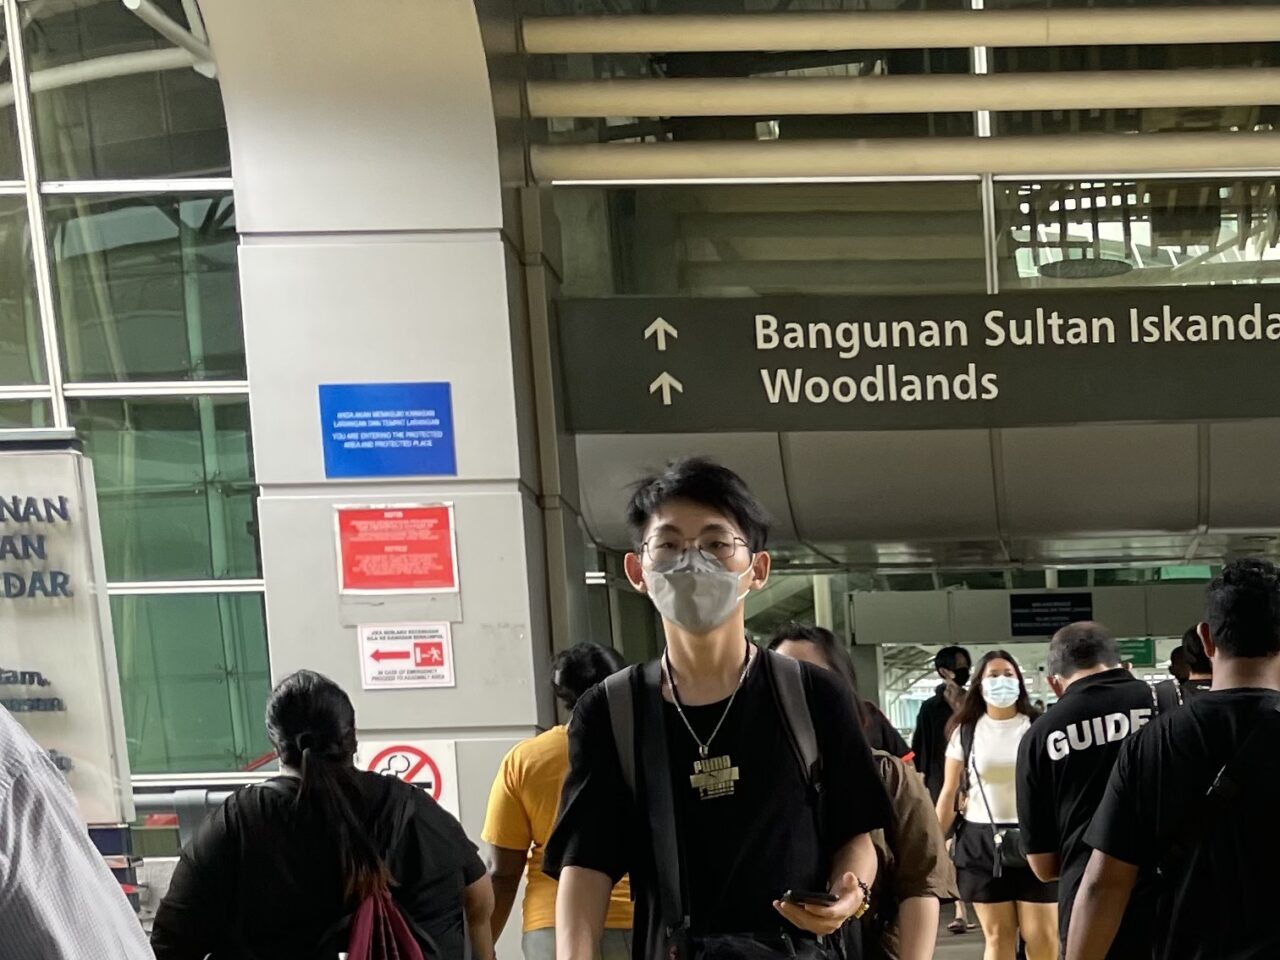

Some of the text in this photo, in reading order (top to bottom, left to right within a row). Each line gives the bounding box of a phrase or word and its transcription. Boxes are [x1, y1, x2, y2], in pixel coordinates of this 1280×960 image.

[755, 314, 968, 359] Bangunan
[984, 307, 1116, 347] Sultan
[760, 363, 999, 403] Woodlands
